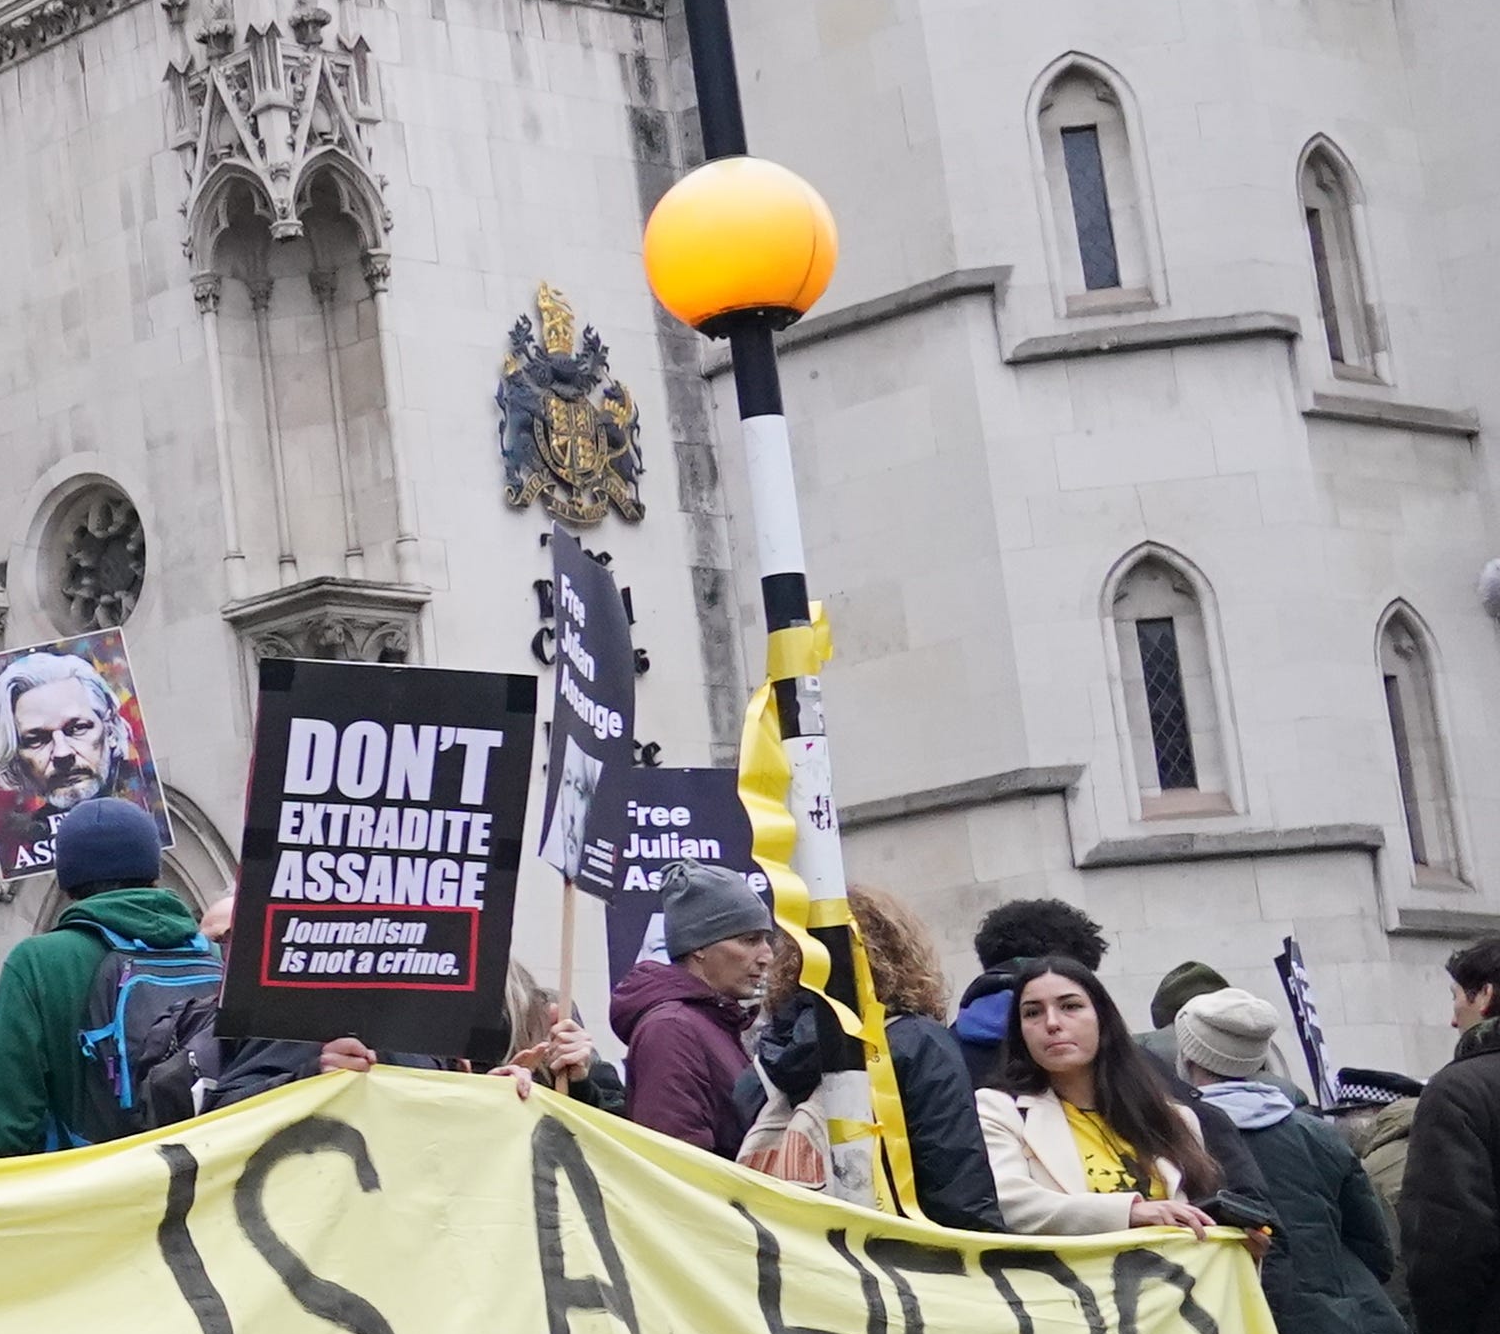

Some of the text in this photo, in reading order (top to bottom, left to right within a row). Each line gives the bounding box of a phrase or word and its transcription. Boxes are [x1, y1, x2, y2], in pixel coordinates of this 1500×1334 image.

[560, 573, 586, 628] Free
[560, 620, 595, 683] Julian
[560, 663, 624, 740] Assange
[283, 717, 504, 805] DON'T
[277, 800, 493, 856] EXTRADITE
[622, 831, 721, 859] Julian
[269, 849, 488, 911] ASSANGE
[281, 917, 428, 945] Journalism
[279, 947, 460, 976] is not a crime.
